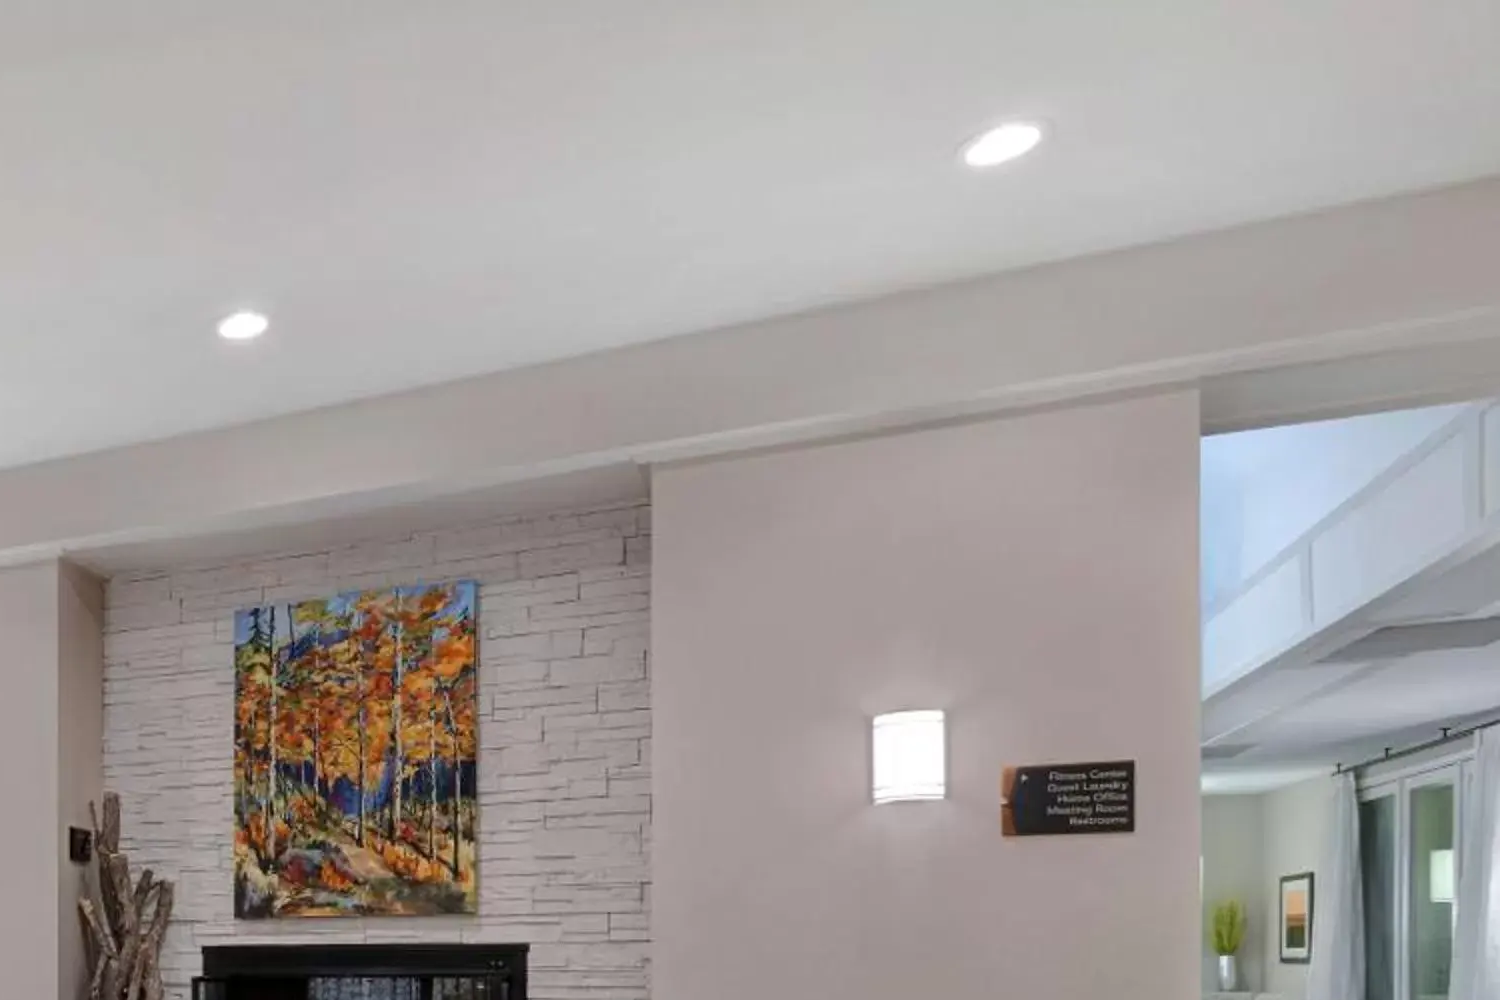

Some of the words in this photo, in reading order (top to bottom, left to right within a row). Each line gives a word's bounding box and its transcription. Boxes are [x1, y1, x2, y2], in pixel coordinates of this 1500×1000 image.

[1089, 768, 1128, 779] Center
[1083, 780, 1129, 792] Laundry
[1093, 792, 1128, 802] Office
[1095, 803, 1129, 813] Room
[1069, 816, 1128, 825] Restrooms
